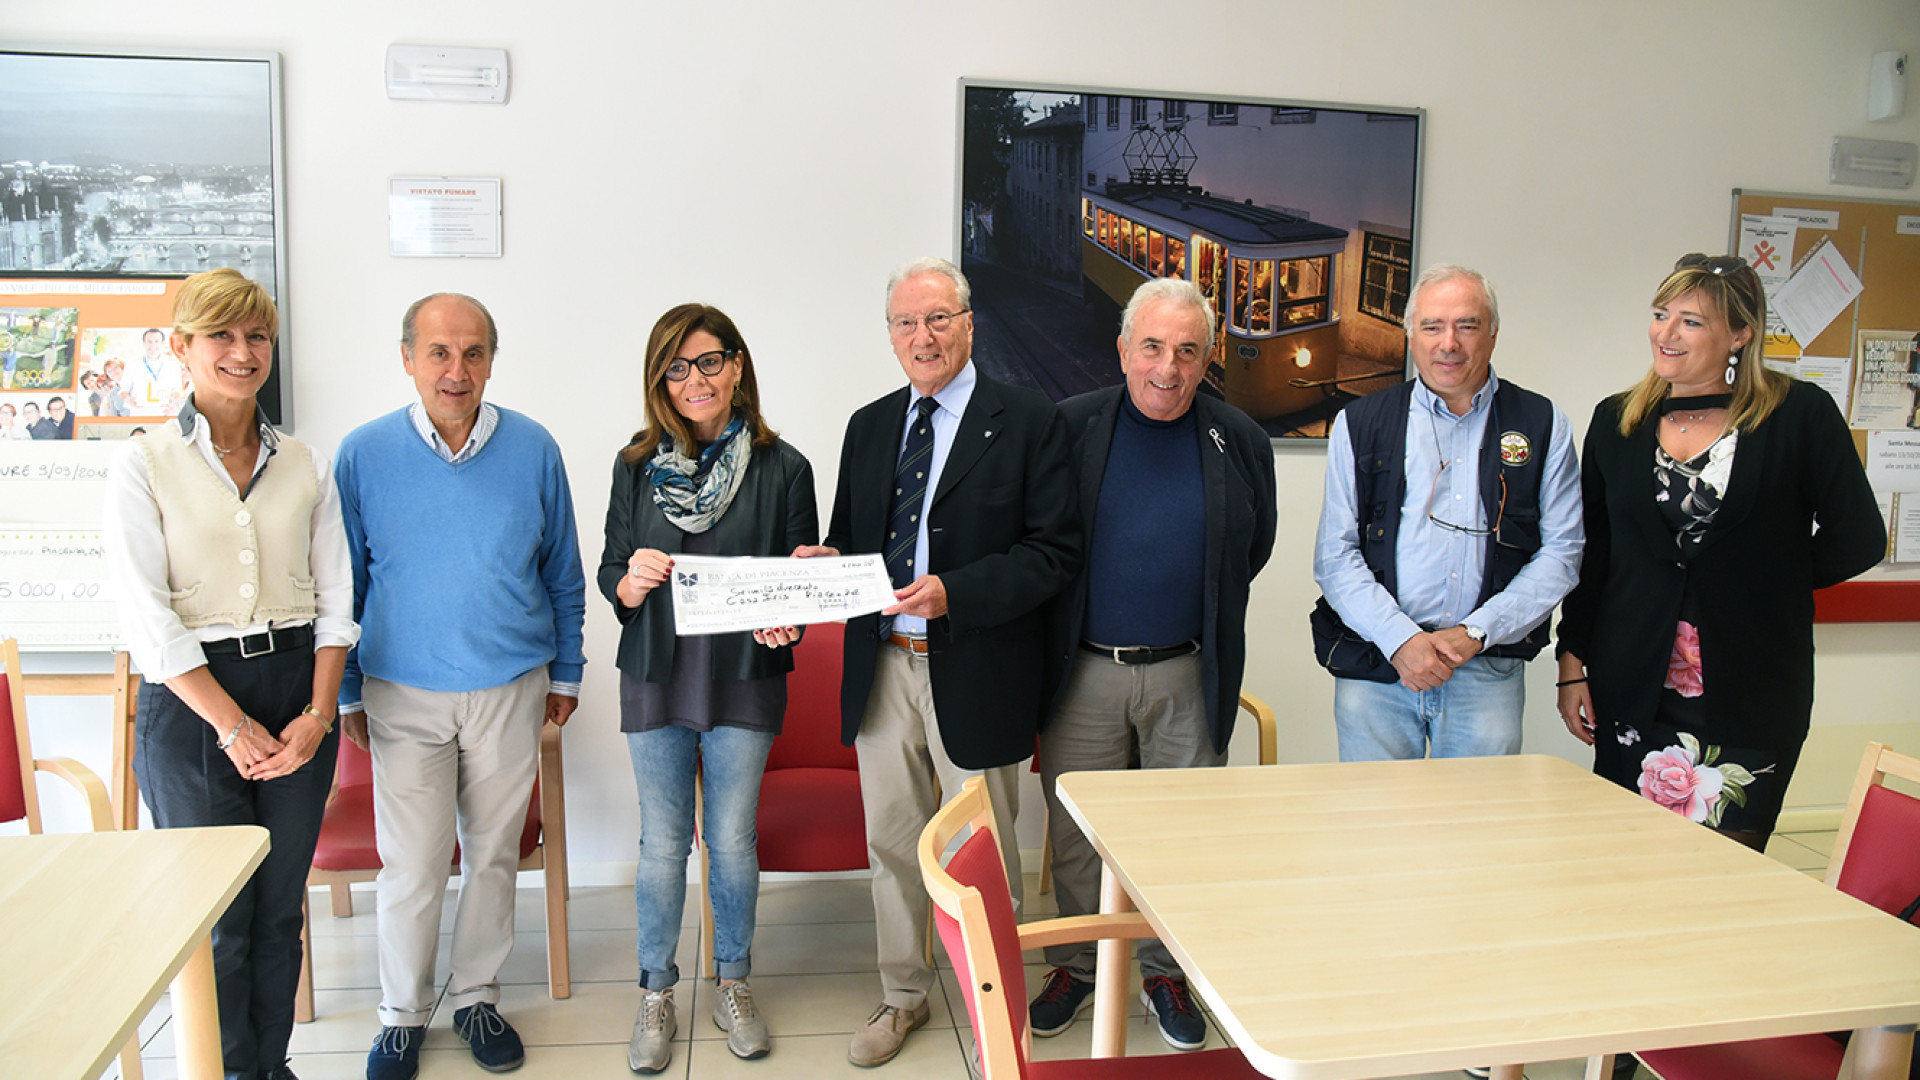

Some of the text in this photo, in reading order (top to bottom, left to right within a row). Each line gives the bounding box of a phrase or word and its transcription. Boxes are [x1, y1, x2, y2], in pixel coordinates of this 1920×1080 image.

[410, 188, 477, 196] VIETATO FUMARE
[10, 283, 35, 292] VALE
[68, 284, 79, 292] DI
[83, 284, 112, 292] MILLE
